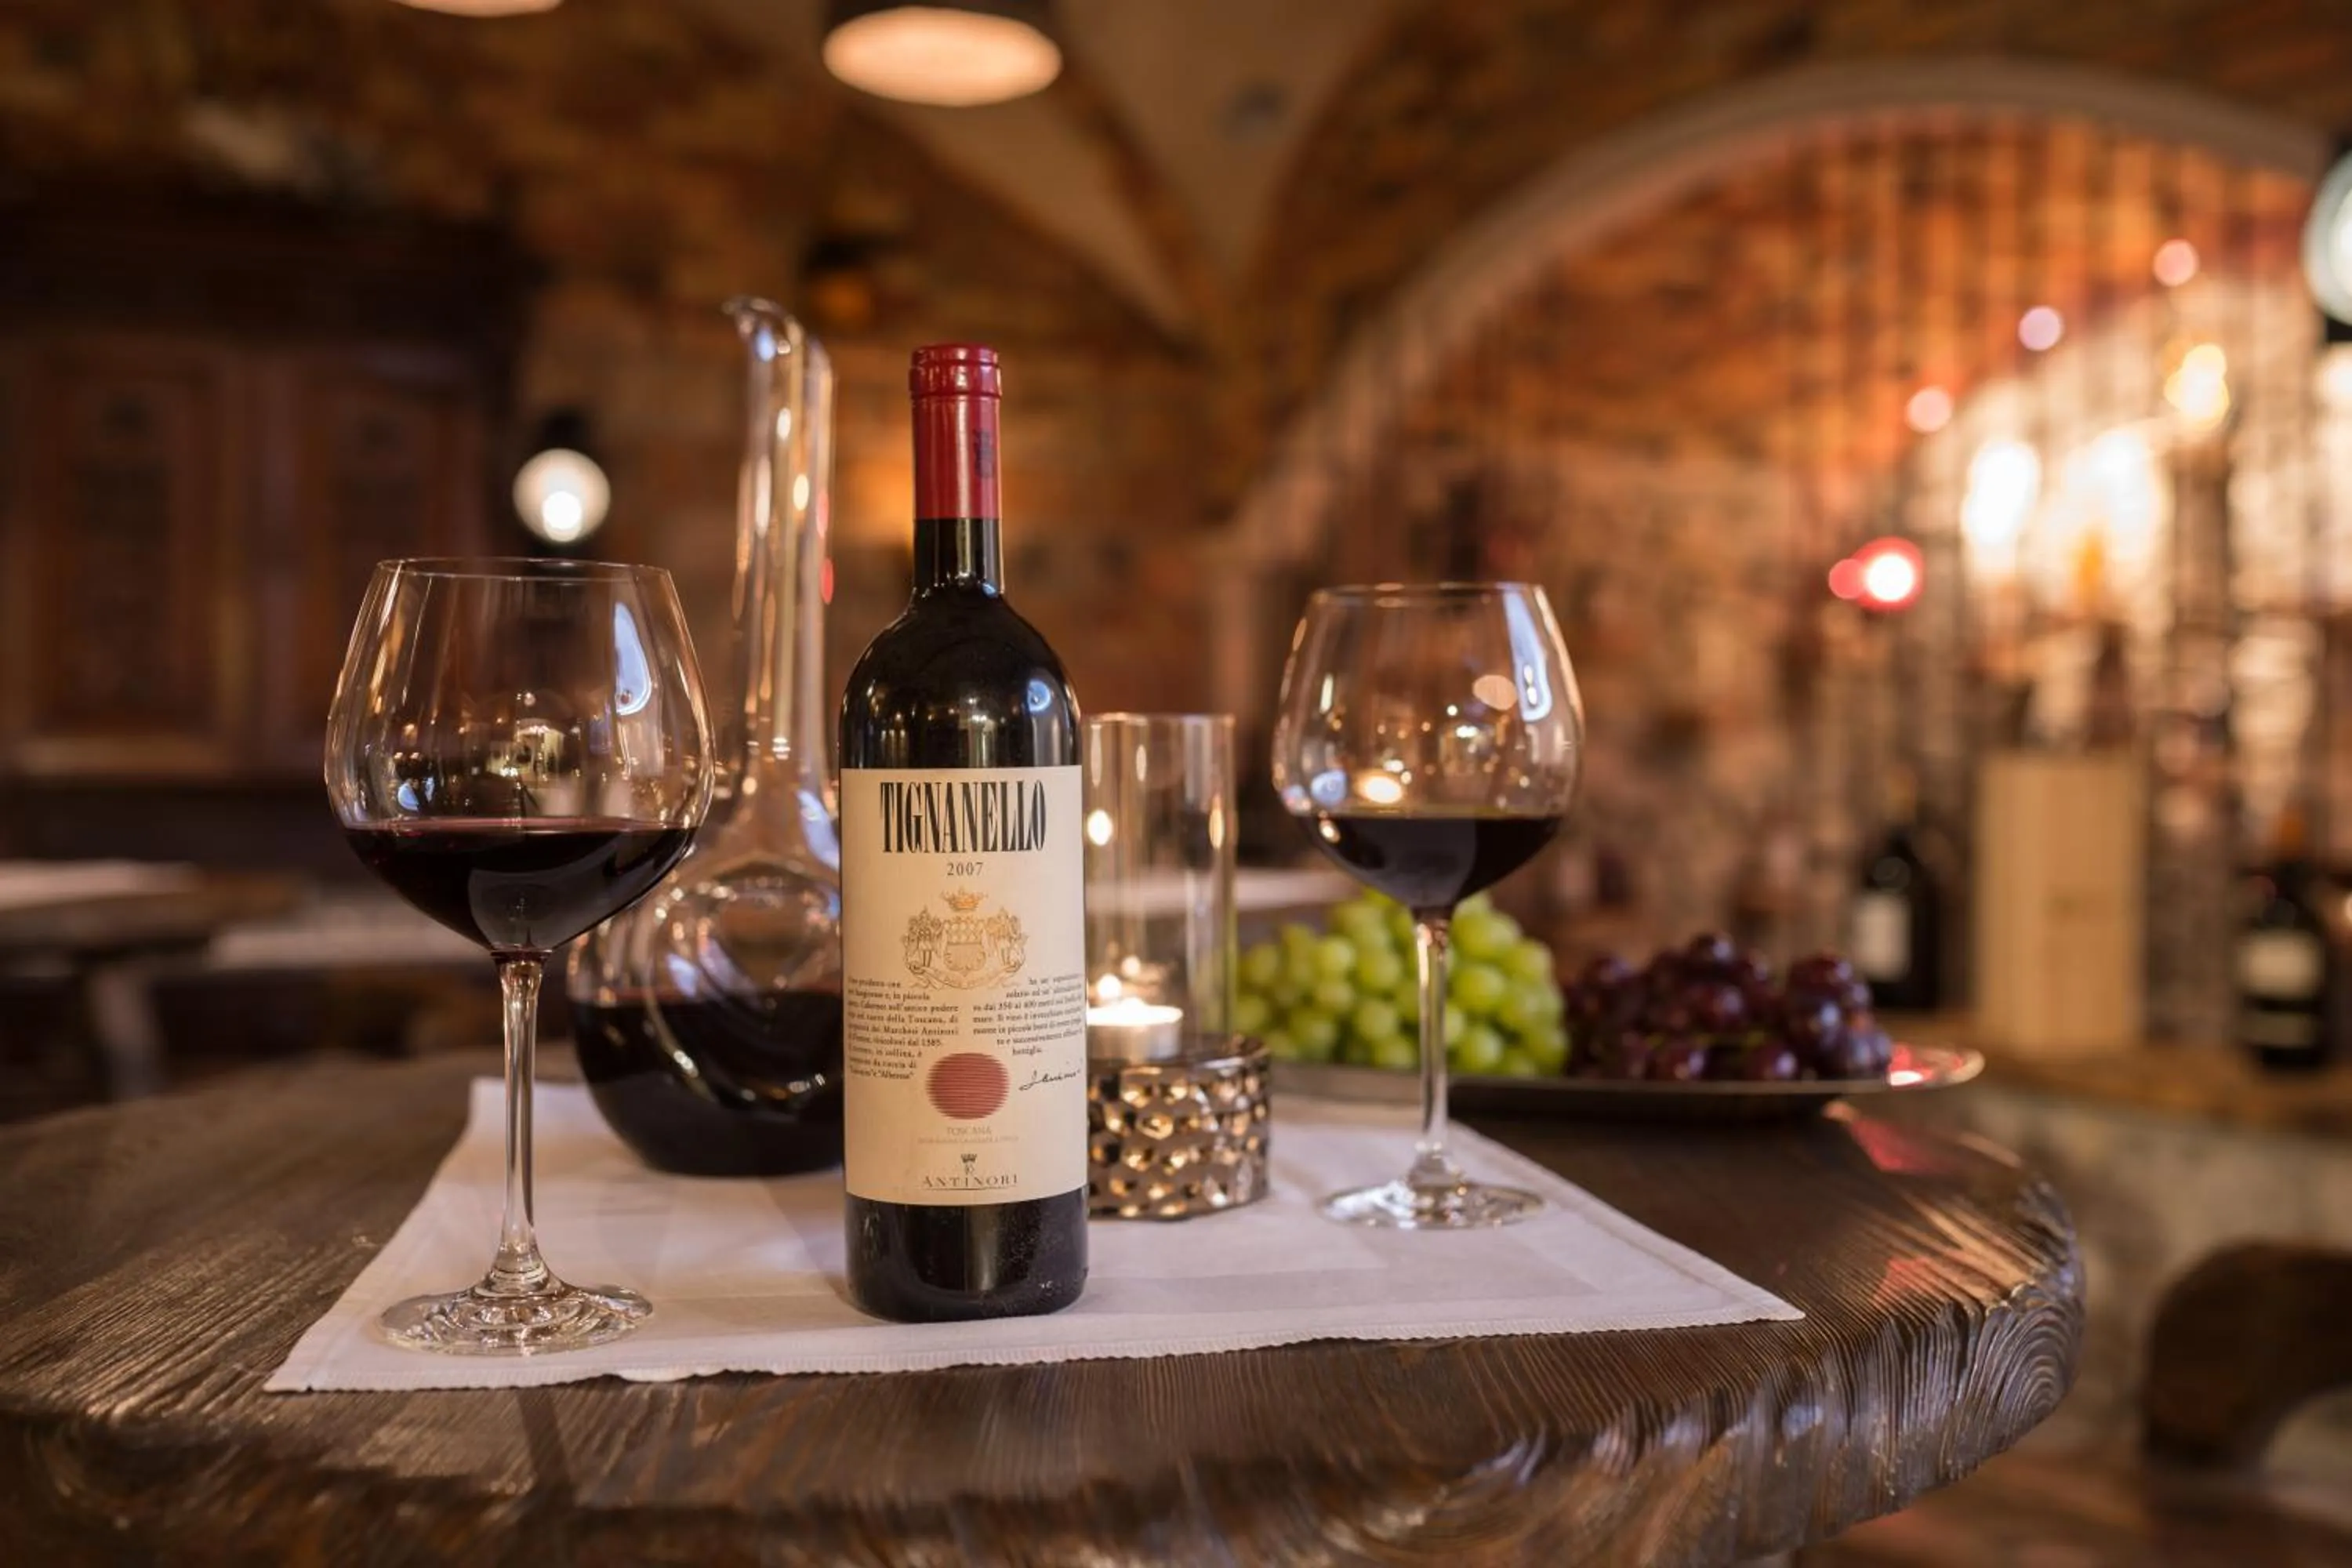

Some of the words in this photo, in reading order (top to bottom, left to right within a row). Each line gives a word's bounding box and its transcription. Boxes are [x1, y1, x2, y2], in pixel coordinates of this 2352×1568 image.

[880, 779, 1047, 854] TIGNANELLO
[947, 862, 984, 876] 2007
[931, 1004, 958, 1013] podere
[887, 1013, 905, 1022] della
[908, 1014, 946, 1023] Toscana,
[949, 1014, 959, 1023] di
[923, 1174, 1018, 1188] ANTINORI
